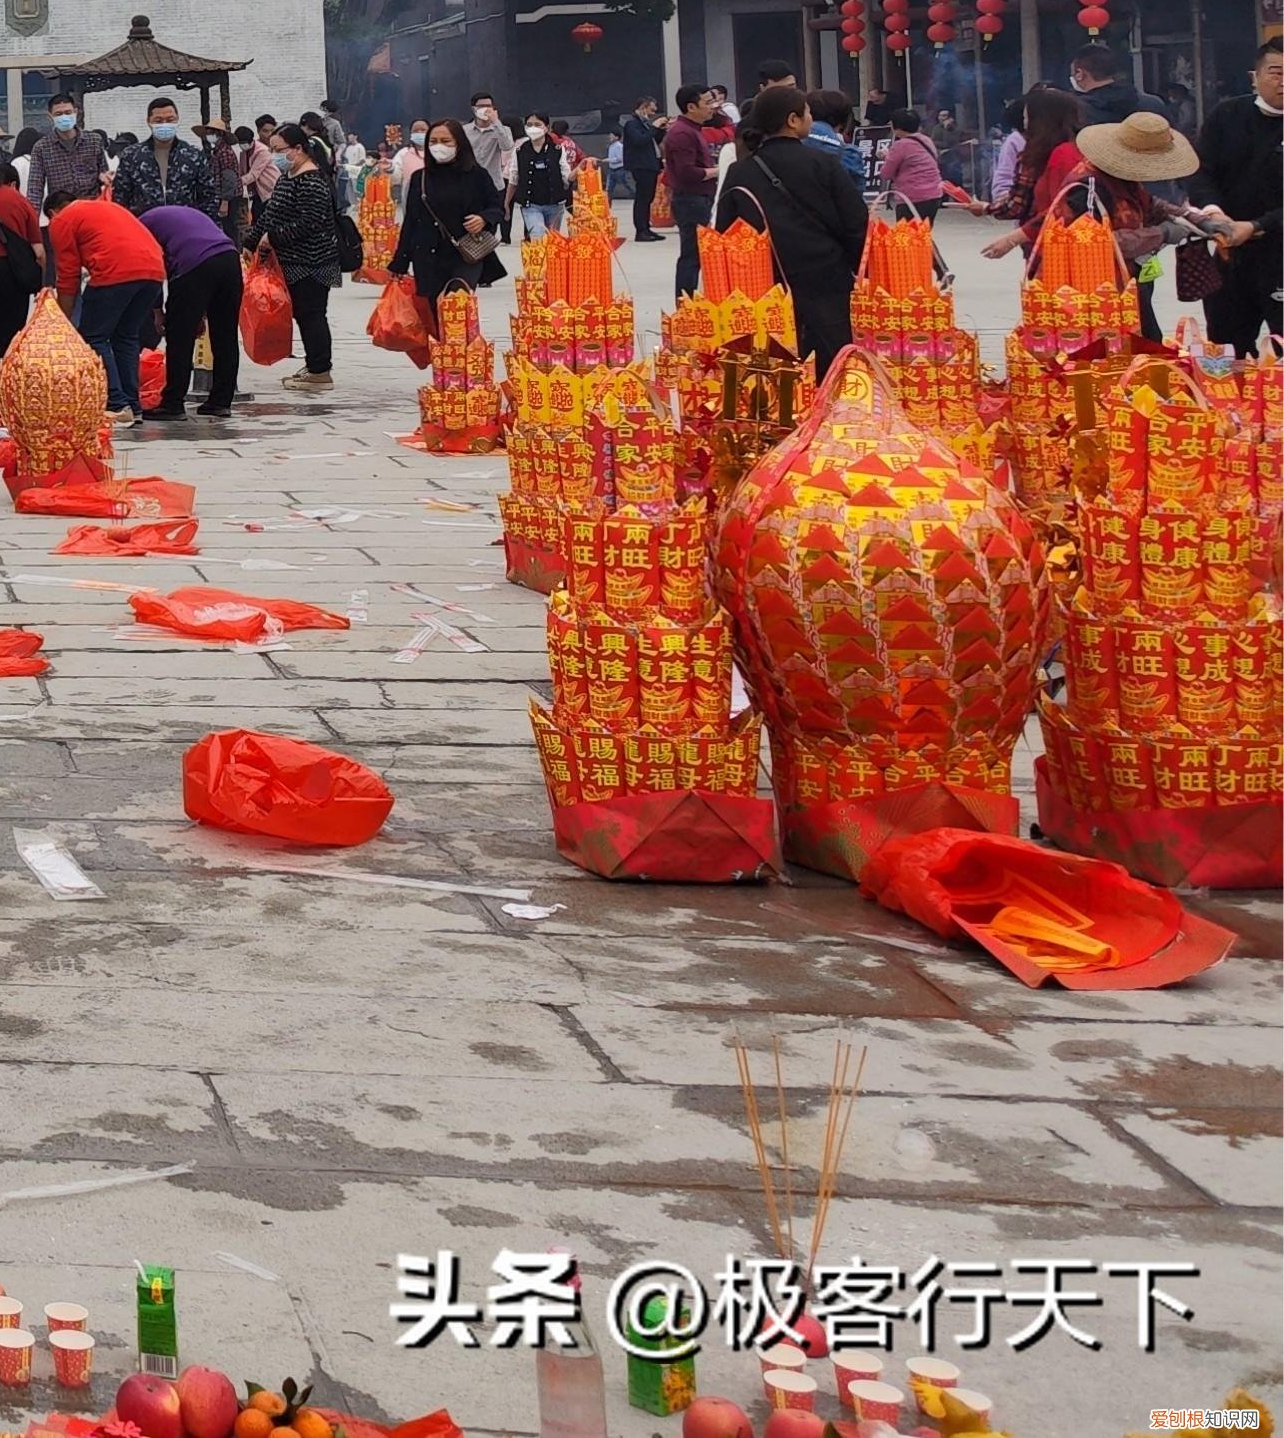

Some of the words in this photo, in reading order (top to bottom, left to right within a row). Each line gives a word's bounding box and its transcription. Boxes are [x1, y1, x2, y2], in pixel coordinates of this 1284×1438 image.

[616, 420, 639, 465] 合家
[642, 416, 663, 465] 平安
[1148, 413, 1176, 456] 合家
[1178, 412, 1208, 459] 平安
[572, 521, 598, 567] 兩旺
[622, 522, 653, 569] 兩旺
[659, 522, 685, 569] 丁財
[1099, 516, 1131, 565] 健康
[1140, 517, 1166, 563] 身體
[1169, 519, 1201, 570] 健康
[1203, 517, 1232, 563] 身體
[599, 633, 631, 682] 興隆
[659, 634, 689, 682] 興隆
[690, 634, 717, 682] 生意
[1132, 630, 1168, 677] 兩旺
[1199, 633, 1232, 683] 事成
[543, 734, 571, 782] 賜福
[589, 737, 620, 786] 賜福
[646, 743, 676, 790] 賜福
[678, 743, 702, 790] 龍母
[1108, 742, 1147, 790] 兩旺
[1179, 745, 1212, 792] 兩旺
[1244, 747, 1269, 793] 兩旺
